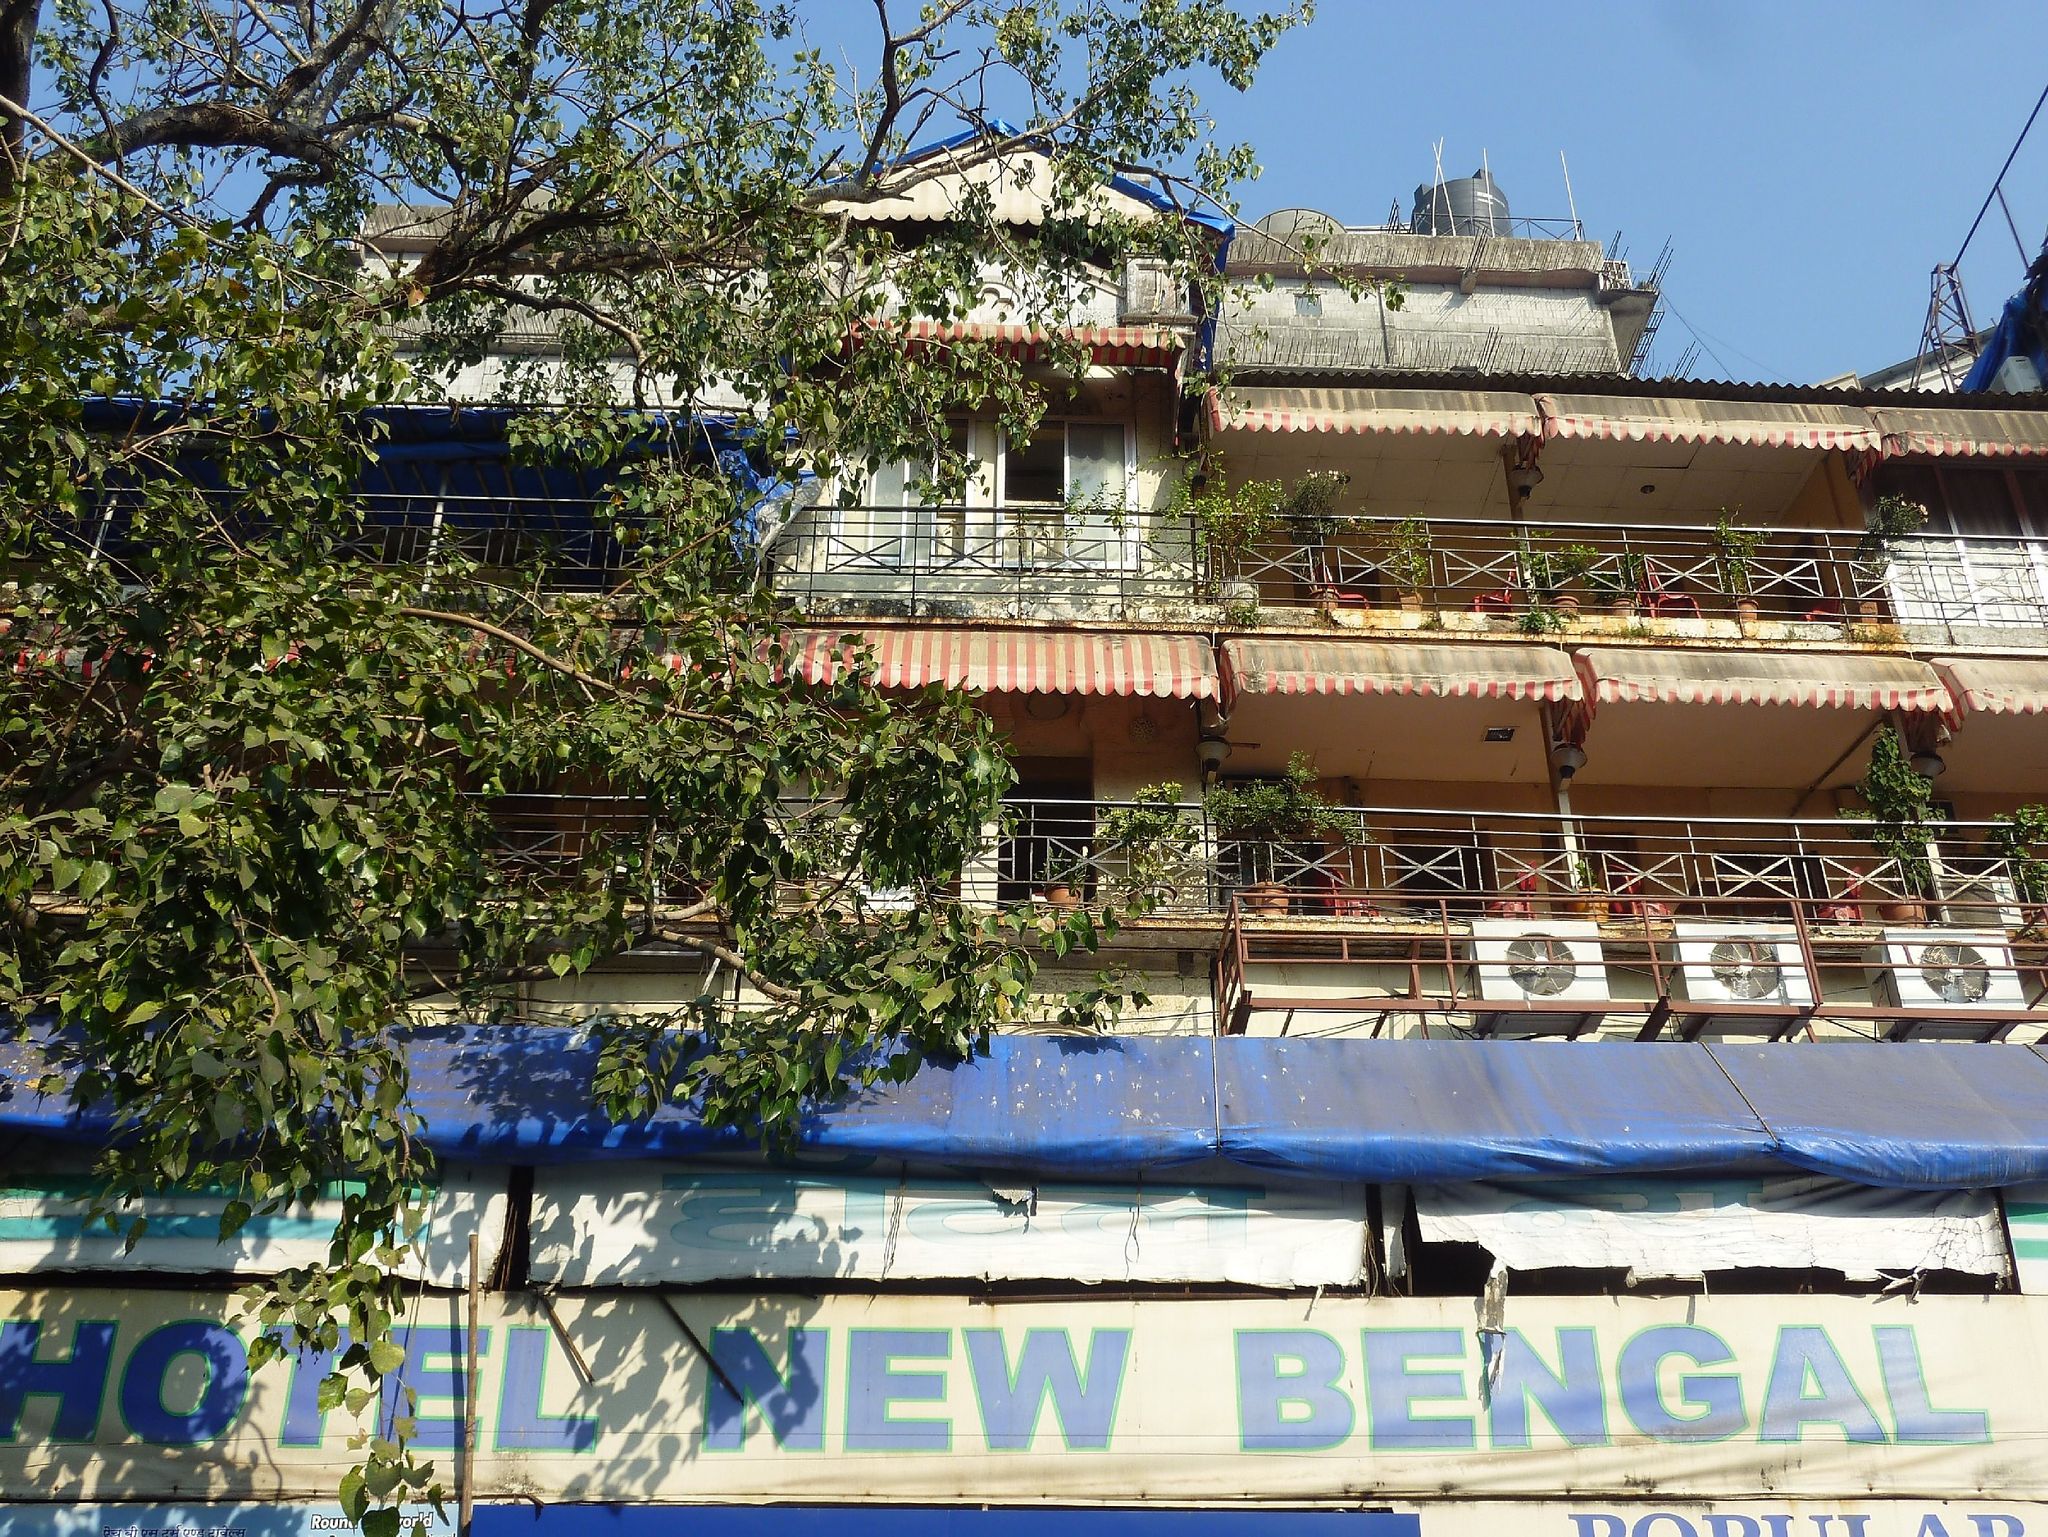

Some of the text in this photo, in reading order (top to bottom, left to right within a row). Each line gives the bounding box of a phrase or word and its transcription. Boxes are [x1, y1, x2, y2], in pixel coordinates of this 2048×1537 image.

[0, 1319, 1992, 1452] HOTEL NEW BENGAL
